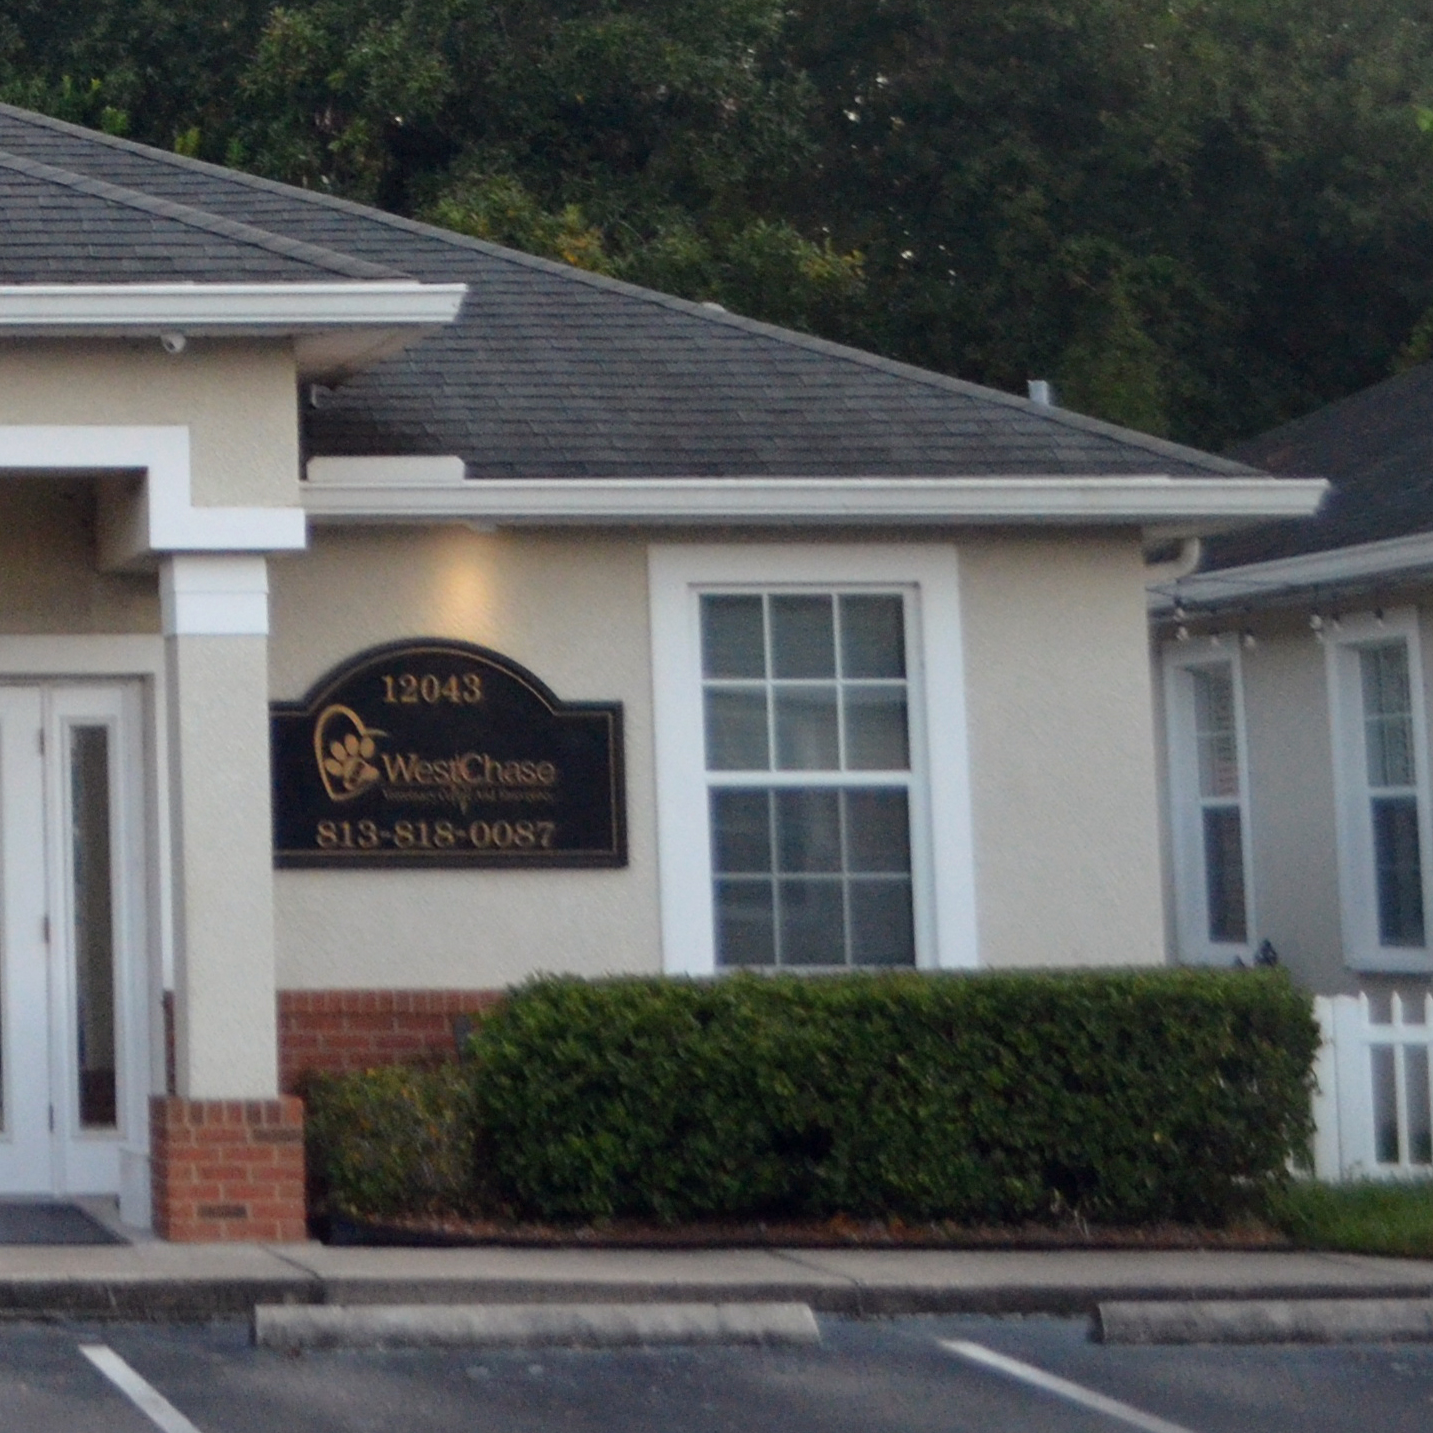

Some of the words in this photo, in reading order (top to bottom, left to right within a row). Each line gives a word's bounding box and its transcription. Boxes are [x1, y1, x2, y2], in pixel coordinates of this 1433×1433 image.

[381, 674, 482, 704] 12043
[381, 751, 557, 786] WestChase
[315, 820, 557, 849] 813-818-0087
